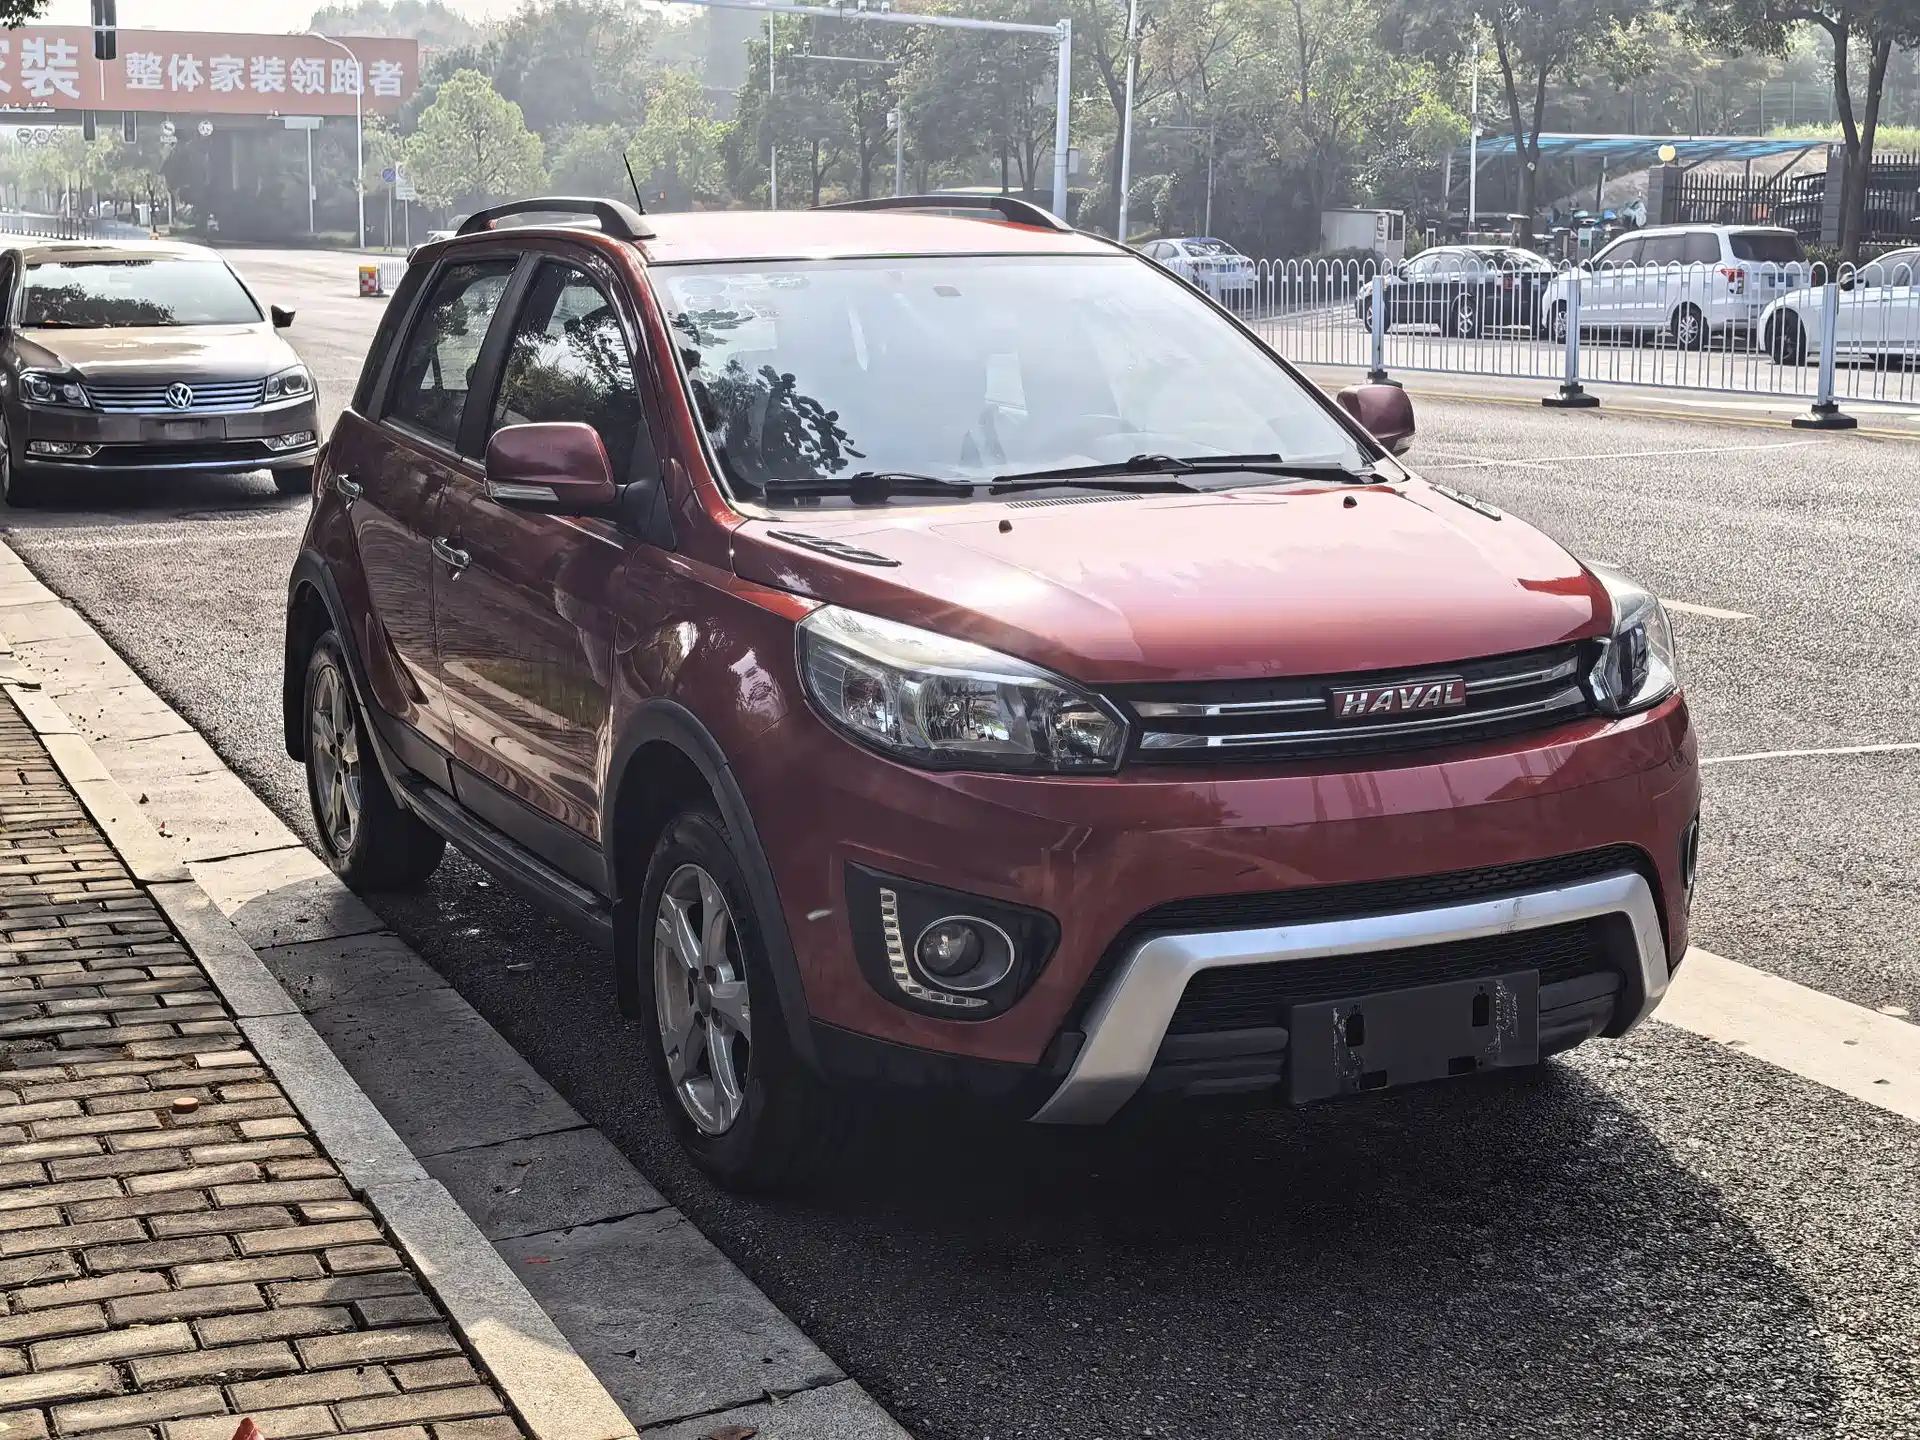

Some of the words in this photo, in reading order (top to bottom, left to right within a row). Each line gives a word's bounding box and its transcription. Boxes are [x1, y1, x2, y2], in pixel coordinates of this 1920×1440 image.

[0, 37, 80, 99] 装
[125, 51, 404, 97] 整体家装领跑者
[1341, 684, 1463, 715] HAVAL
